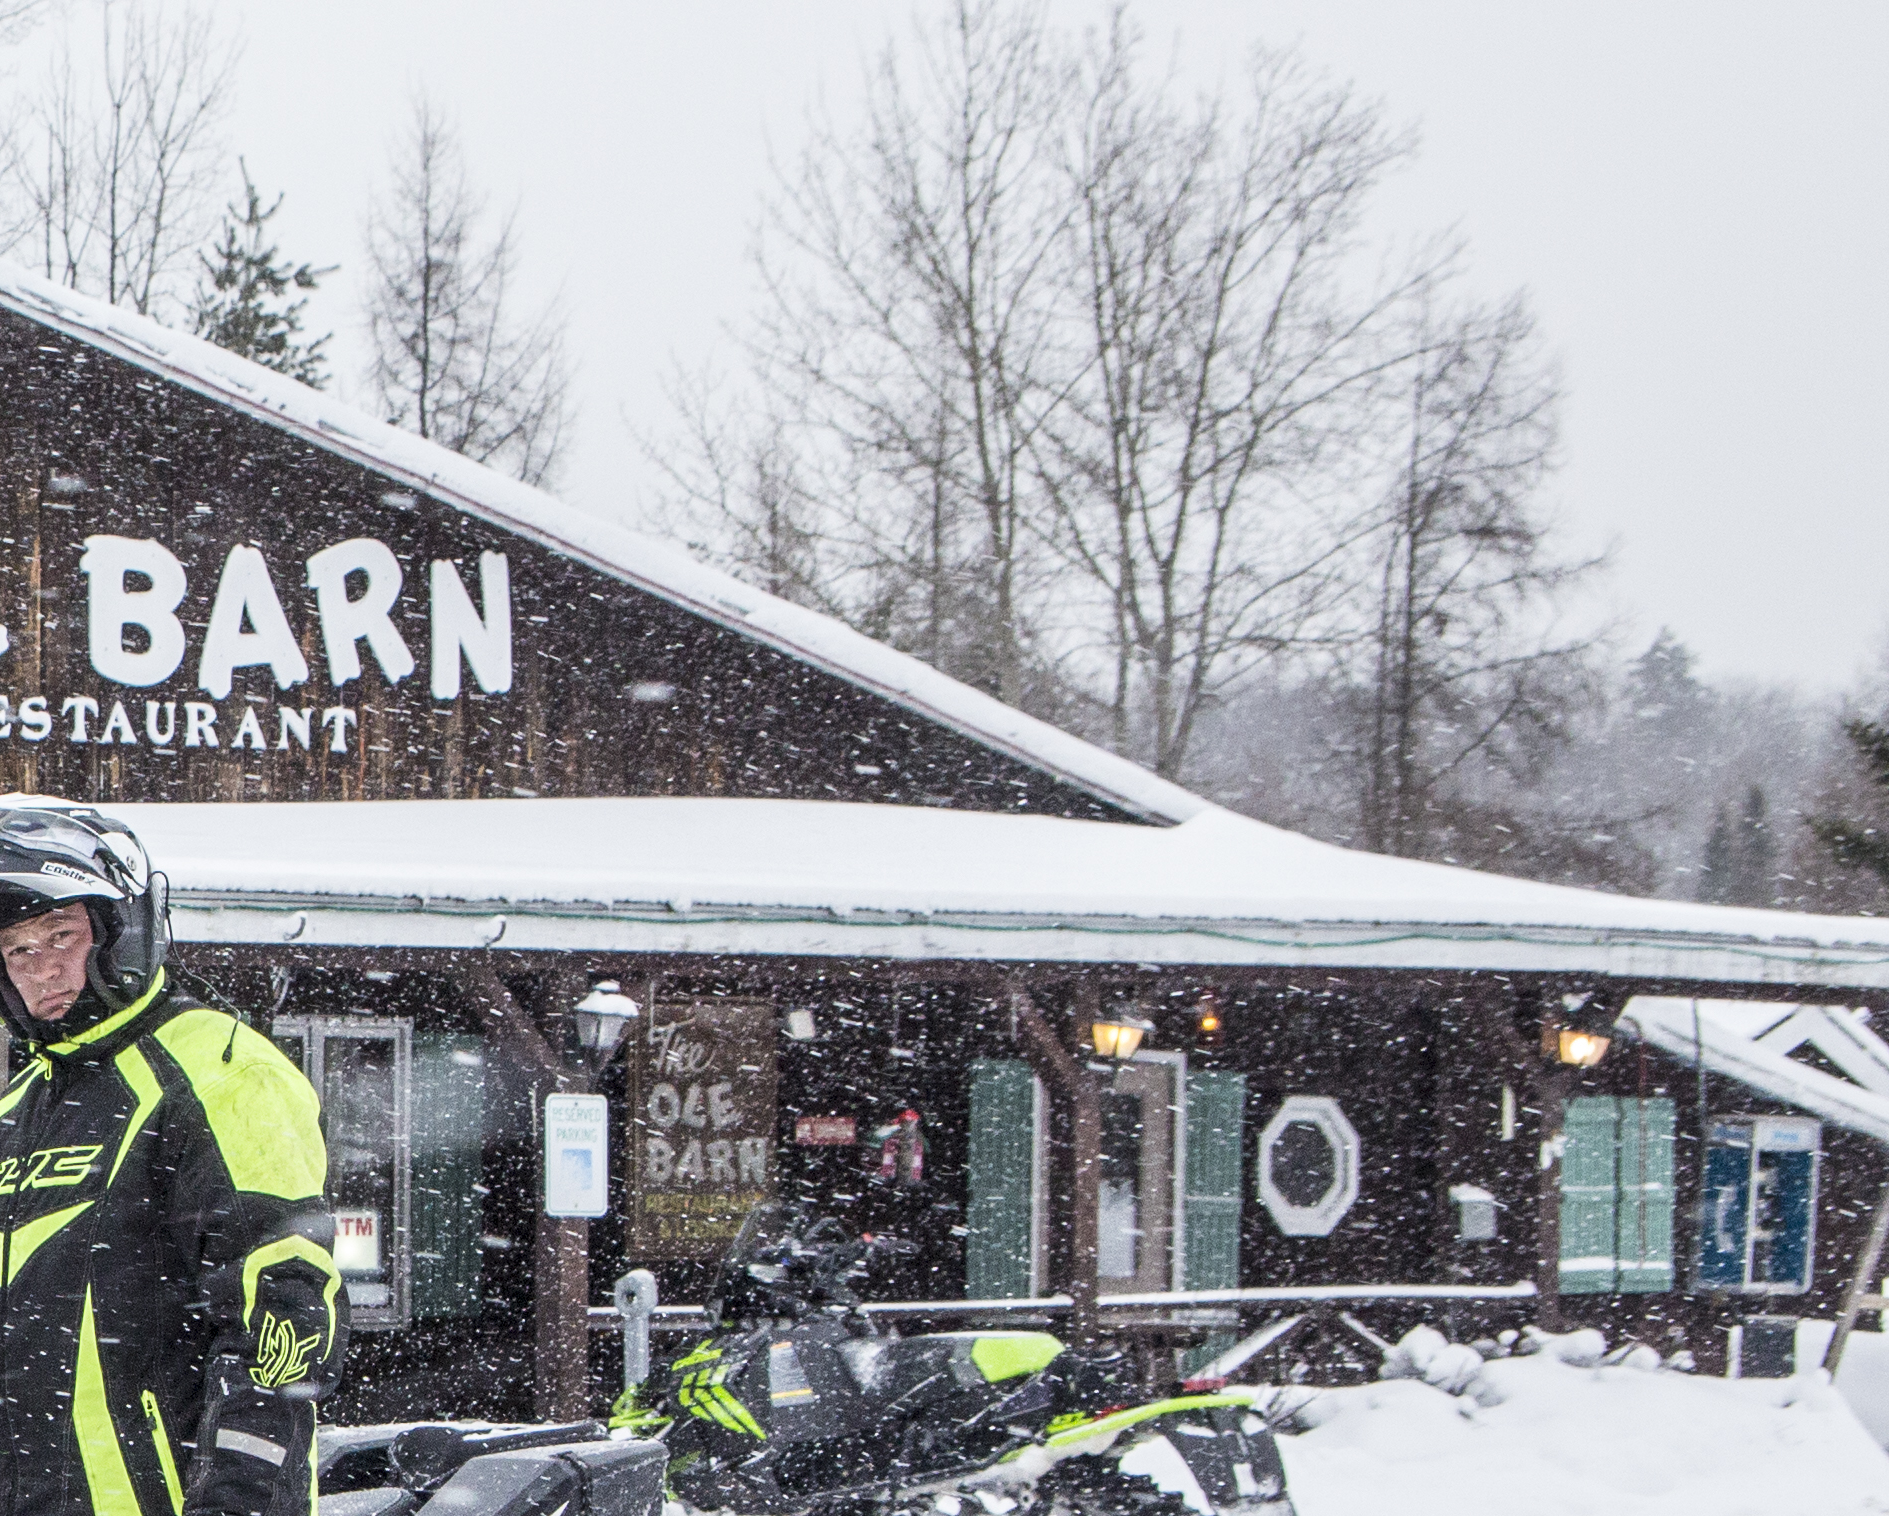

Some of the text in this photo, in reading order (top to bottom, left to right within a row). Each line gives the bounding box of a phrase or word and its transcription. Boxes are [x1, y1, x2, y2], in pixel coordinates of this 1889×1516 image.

[83, 534, 511, 699] BARN
[552, 1107, 601, 1122] RESERVED
[648, 1081, 743, 1128] OLE
[556, 1129, 597, 1143] PARKING
[646, 1137, 768, 1184] BARN
[334, 1217, 373, 1236] TM
